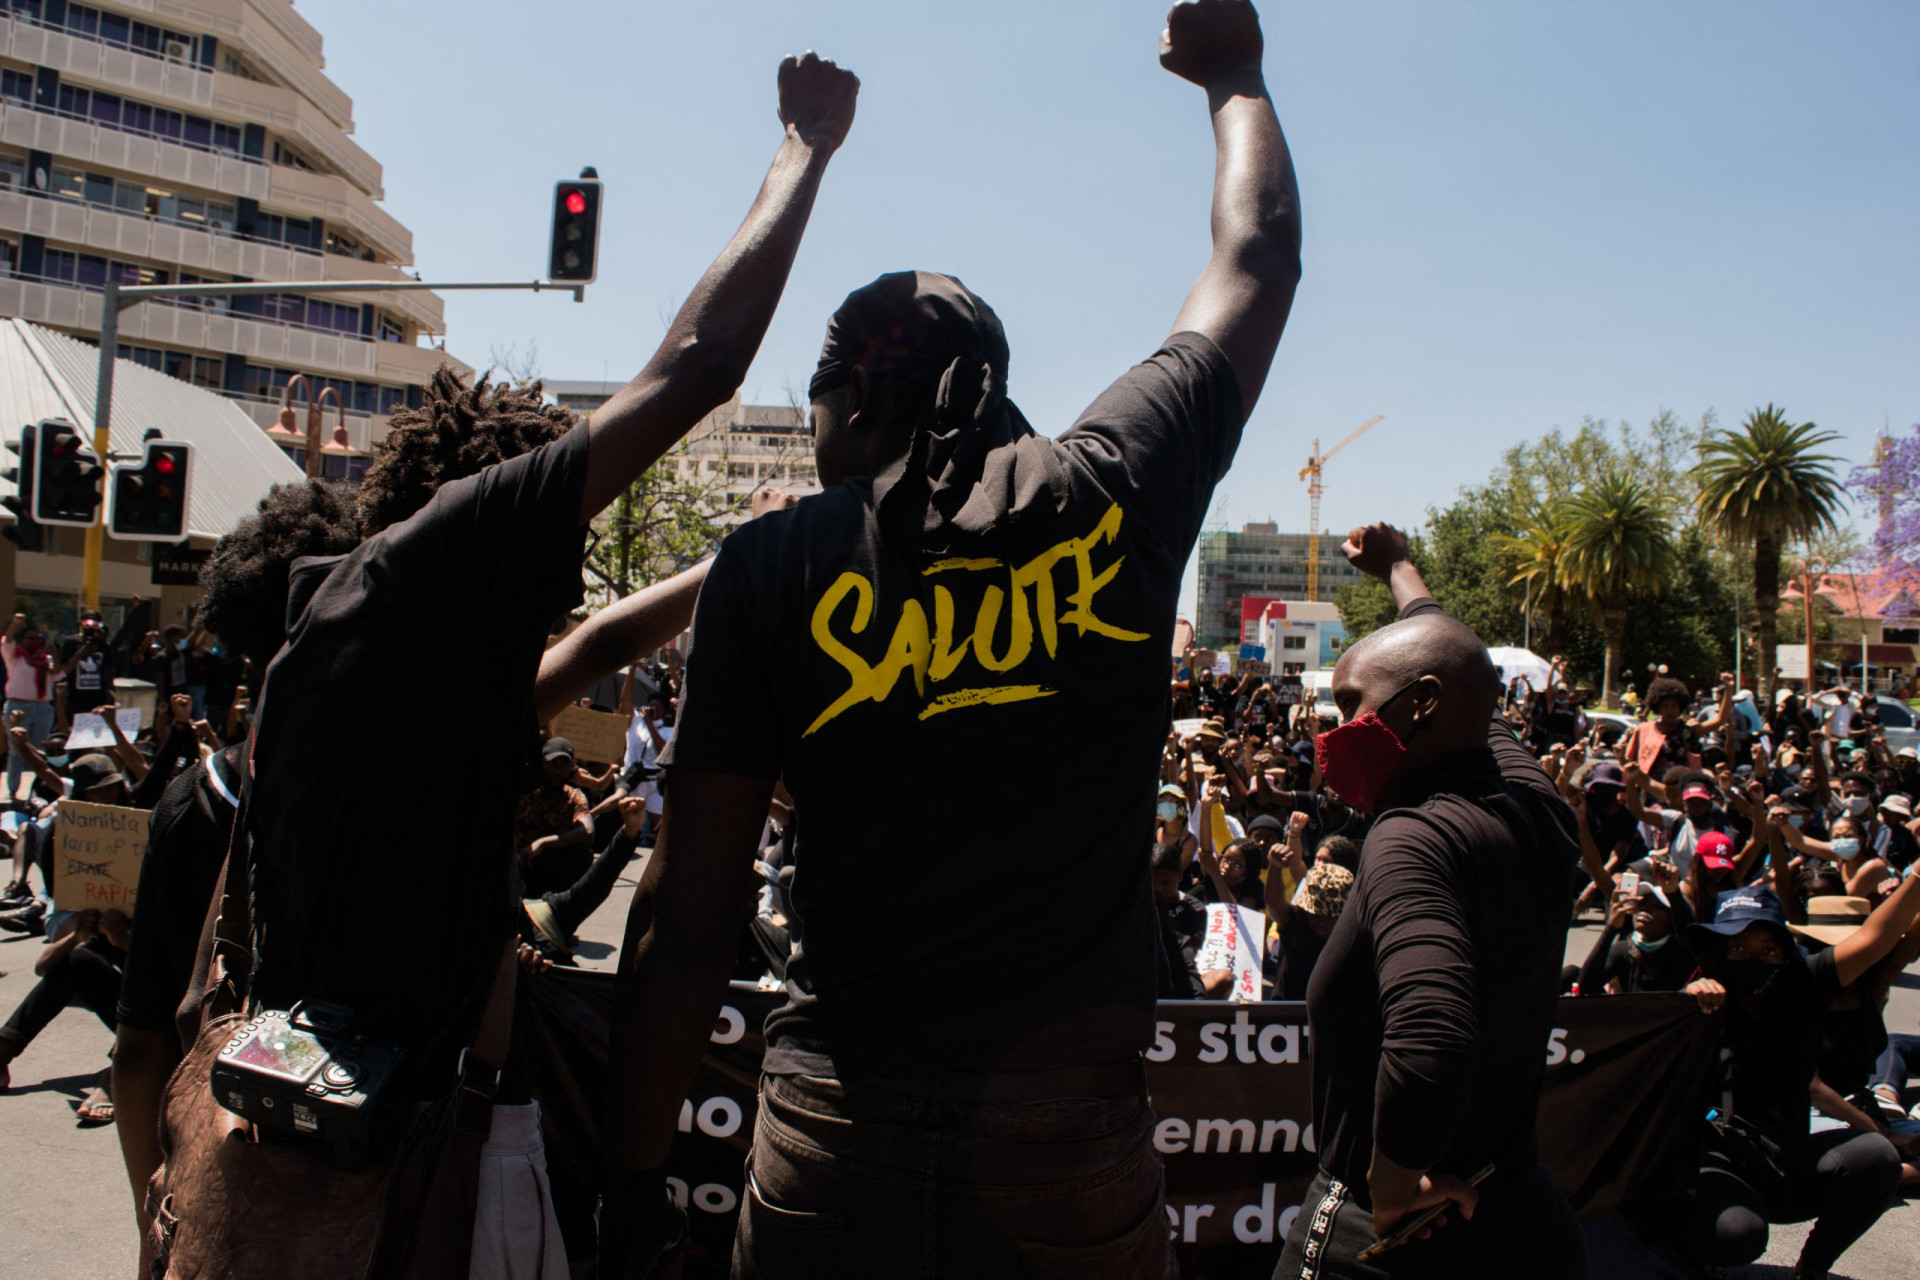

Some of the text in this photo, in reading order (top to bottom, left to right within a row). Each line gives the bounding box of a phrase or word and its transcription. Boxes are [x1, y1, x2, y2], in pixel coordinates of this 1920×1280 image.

[801, 501, 1151, 738] SALUTE
[60, 808, 139, 833] Namibia
[62, 832, 99, 853] land
[105, 838, 126, 855] of
[1224, 953, 1238, 981] ust
[1197, 1010, 1311, 1065] sta
[1313, 1179, 1342, 1234] PROBLEM
